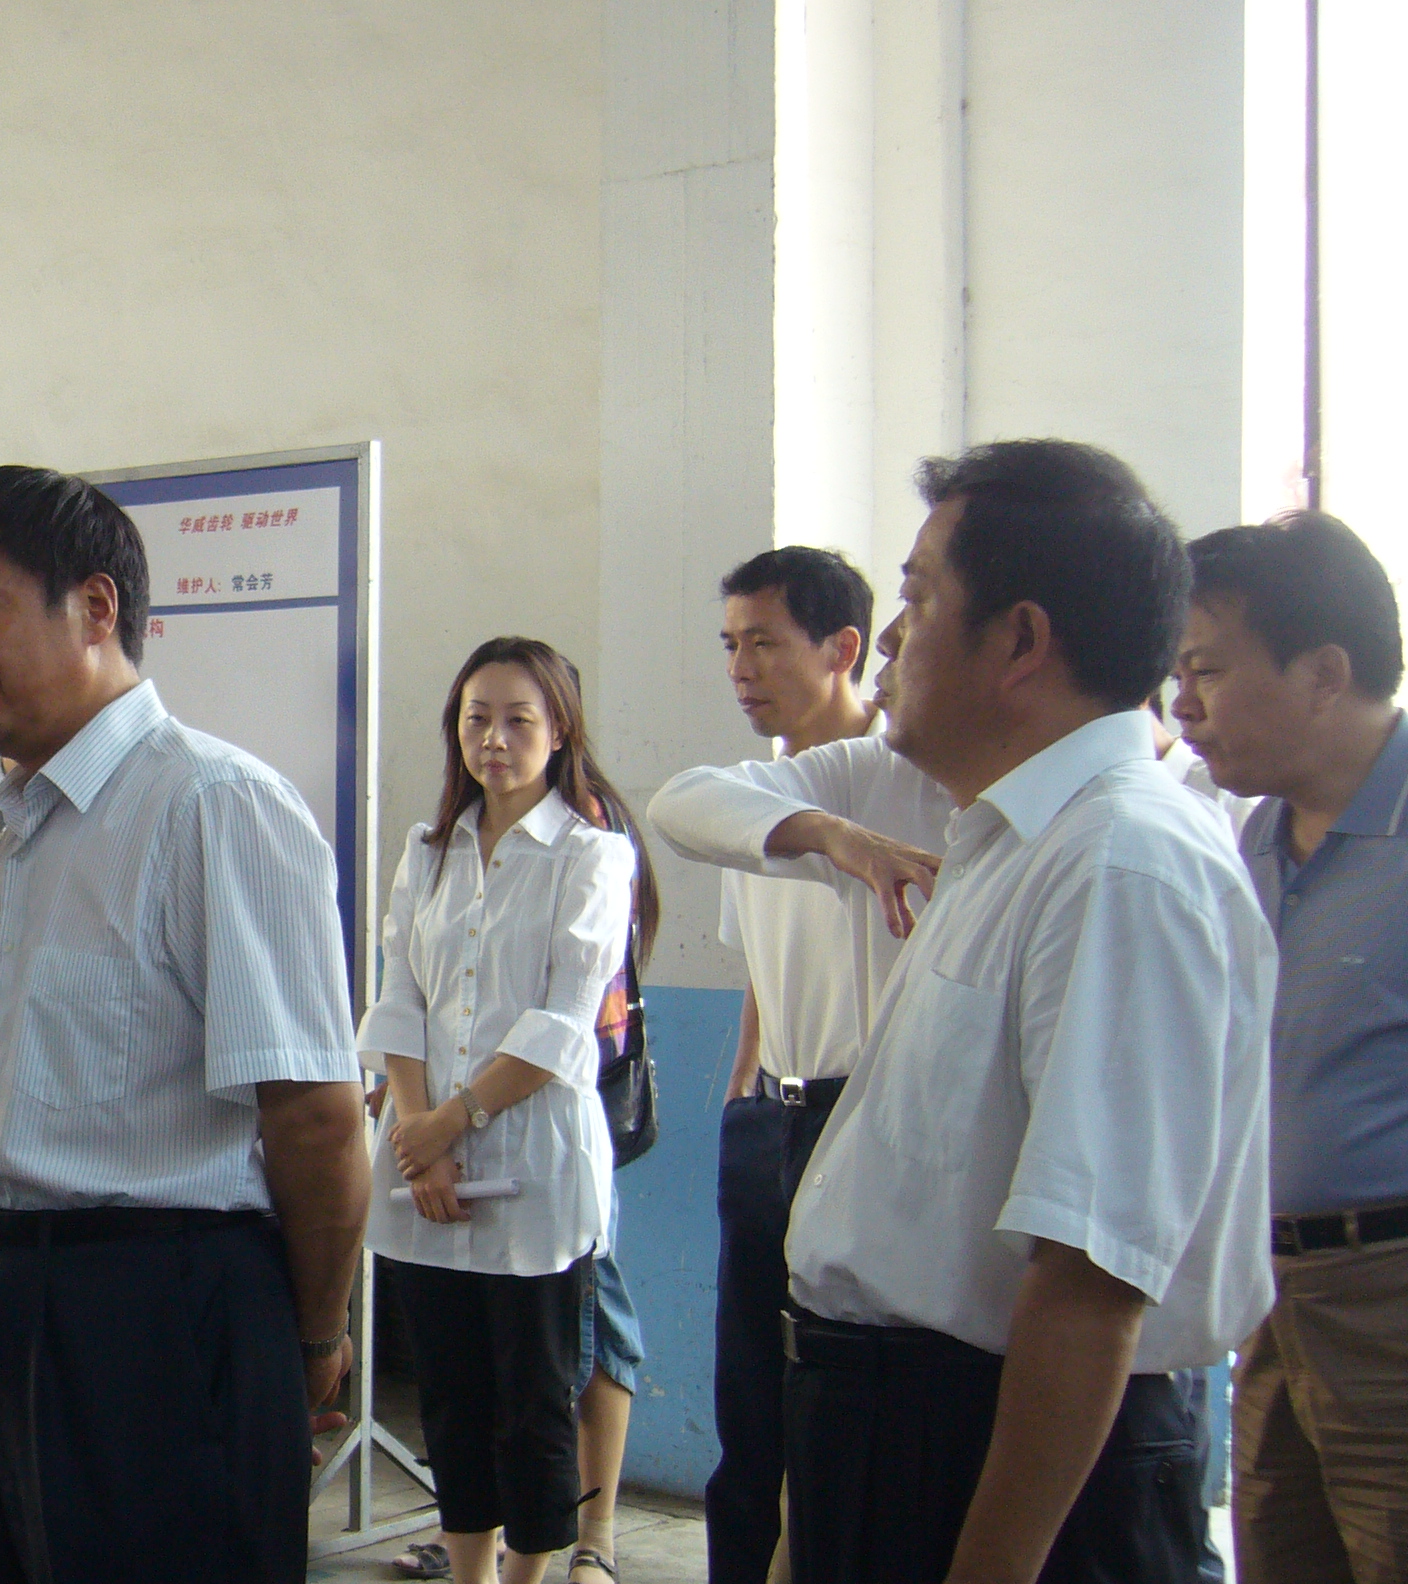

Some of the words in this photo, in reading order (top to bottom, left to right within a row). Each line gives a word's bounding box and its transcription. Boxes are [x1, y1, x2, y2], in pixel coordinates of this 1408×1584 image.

[179, 514, 233, 534] 华威齿轮
[240, 508, 298, 530] 驱动世界
[232, 573, 273, 592] 常会芳
